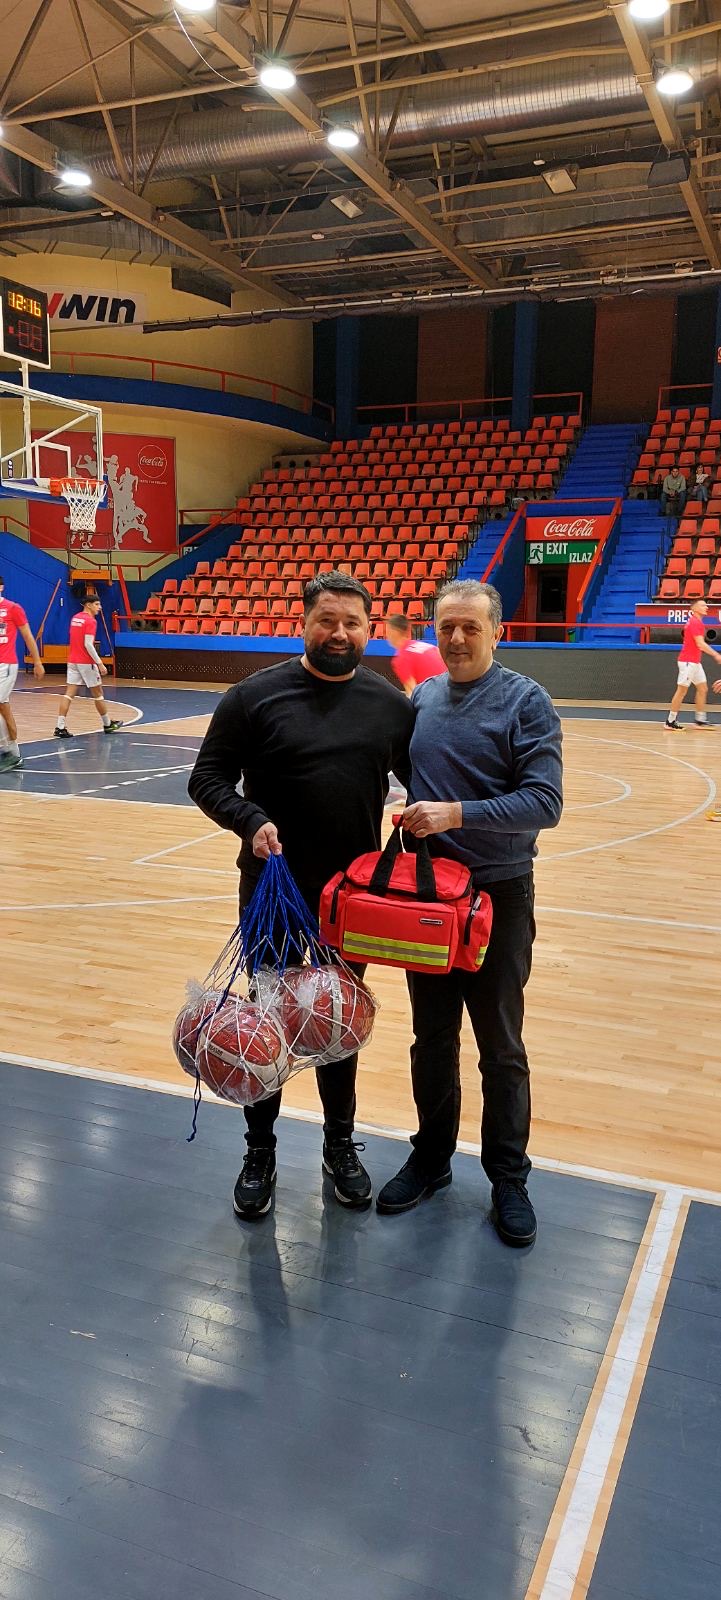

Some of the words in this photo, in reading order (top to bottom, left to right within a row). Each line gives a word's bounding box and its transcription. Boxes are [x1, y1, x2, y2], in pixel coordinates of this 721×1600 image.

[11, 292, 42, 318] 12:16
[543, 518, 597, 537] Coca-Cola
[546, 542, 569, 555] EXIT
[569, 552, 593, 563] IZLAZ
[667, 609, 695, 623] PRES
